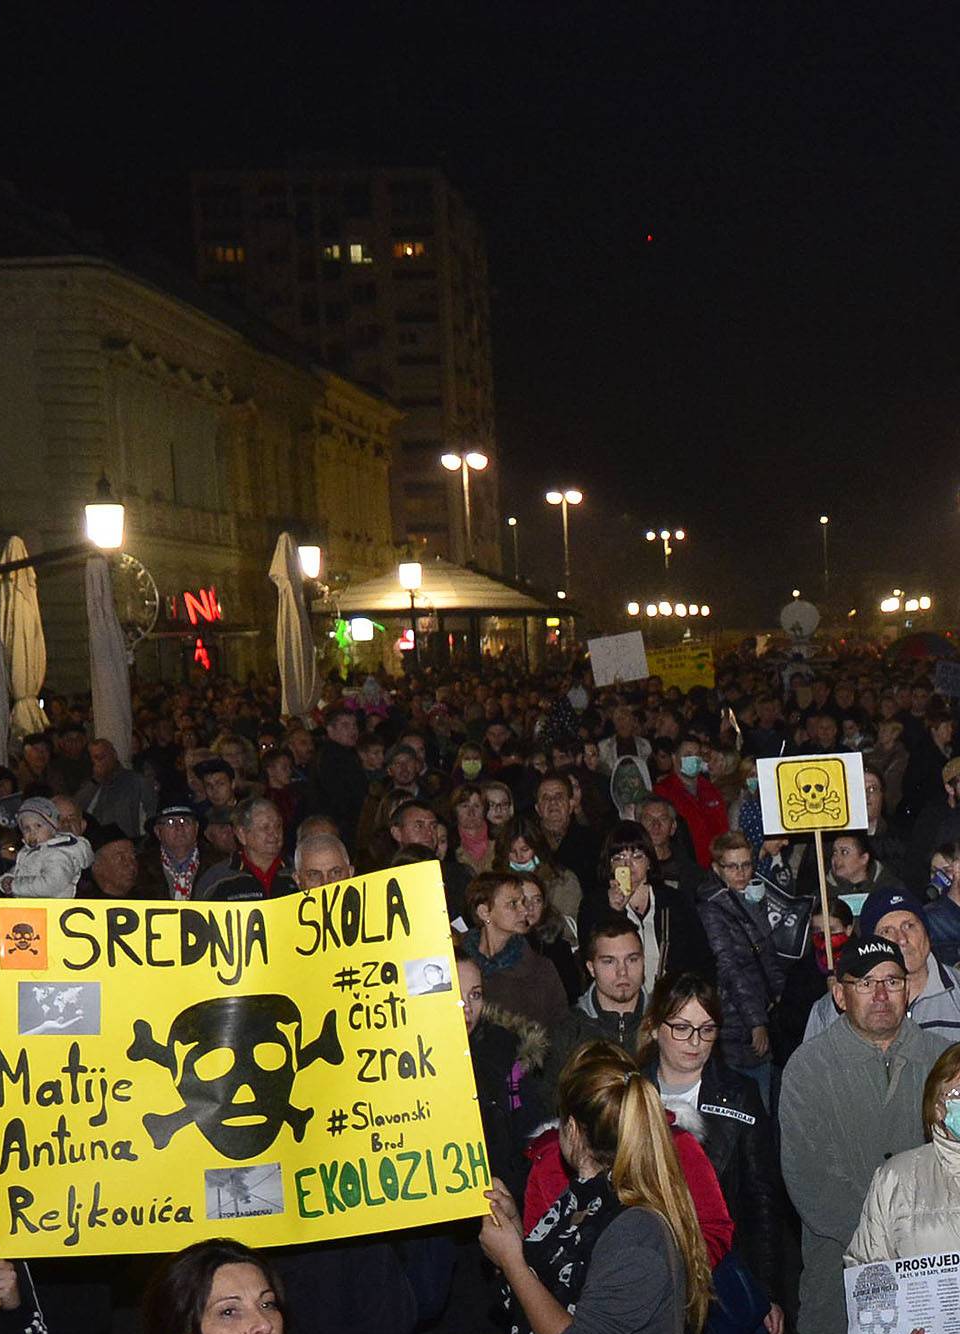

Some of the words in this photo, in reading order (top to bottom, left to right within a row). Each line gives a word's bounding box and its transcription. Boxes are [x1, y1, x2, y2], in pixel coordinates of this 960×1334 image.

[59, 907, 268, 985] SREDNJA
[295, 877, 410, 956] ŠKOLA
[858, 942, 894, 956] MANA
[332, 961, 399, 992] #za
[348, 992, 407, 1030] čisti
[357, 1034, 437, 1082] zrak
[327, 1100, 432, 1136] #Slavonski
[371, 1132, 404, 1153] Brod
[294, 1149, 437, 1219] EKOLOZI
[7, 1181, 194, 1246] Reljkovića
[895, 1254, 960, 1273] PROSVJED
